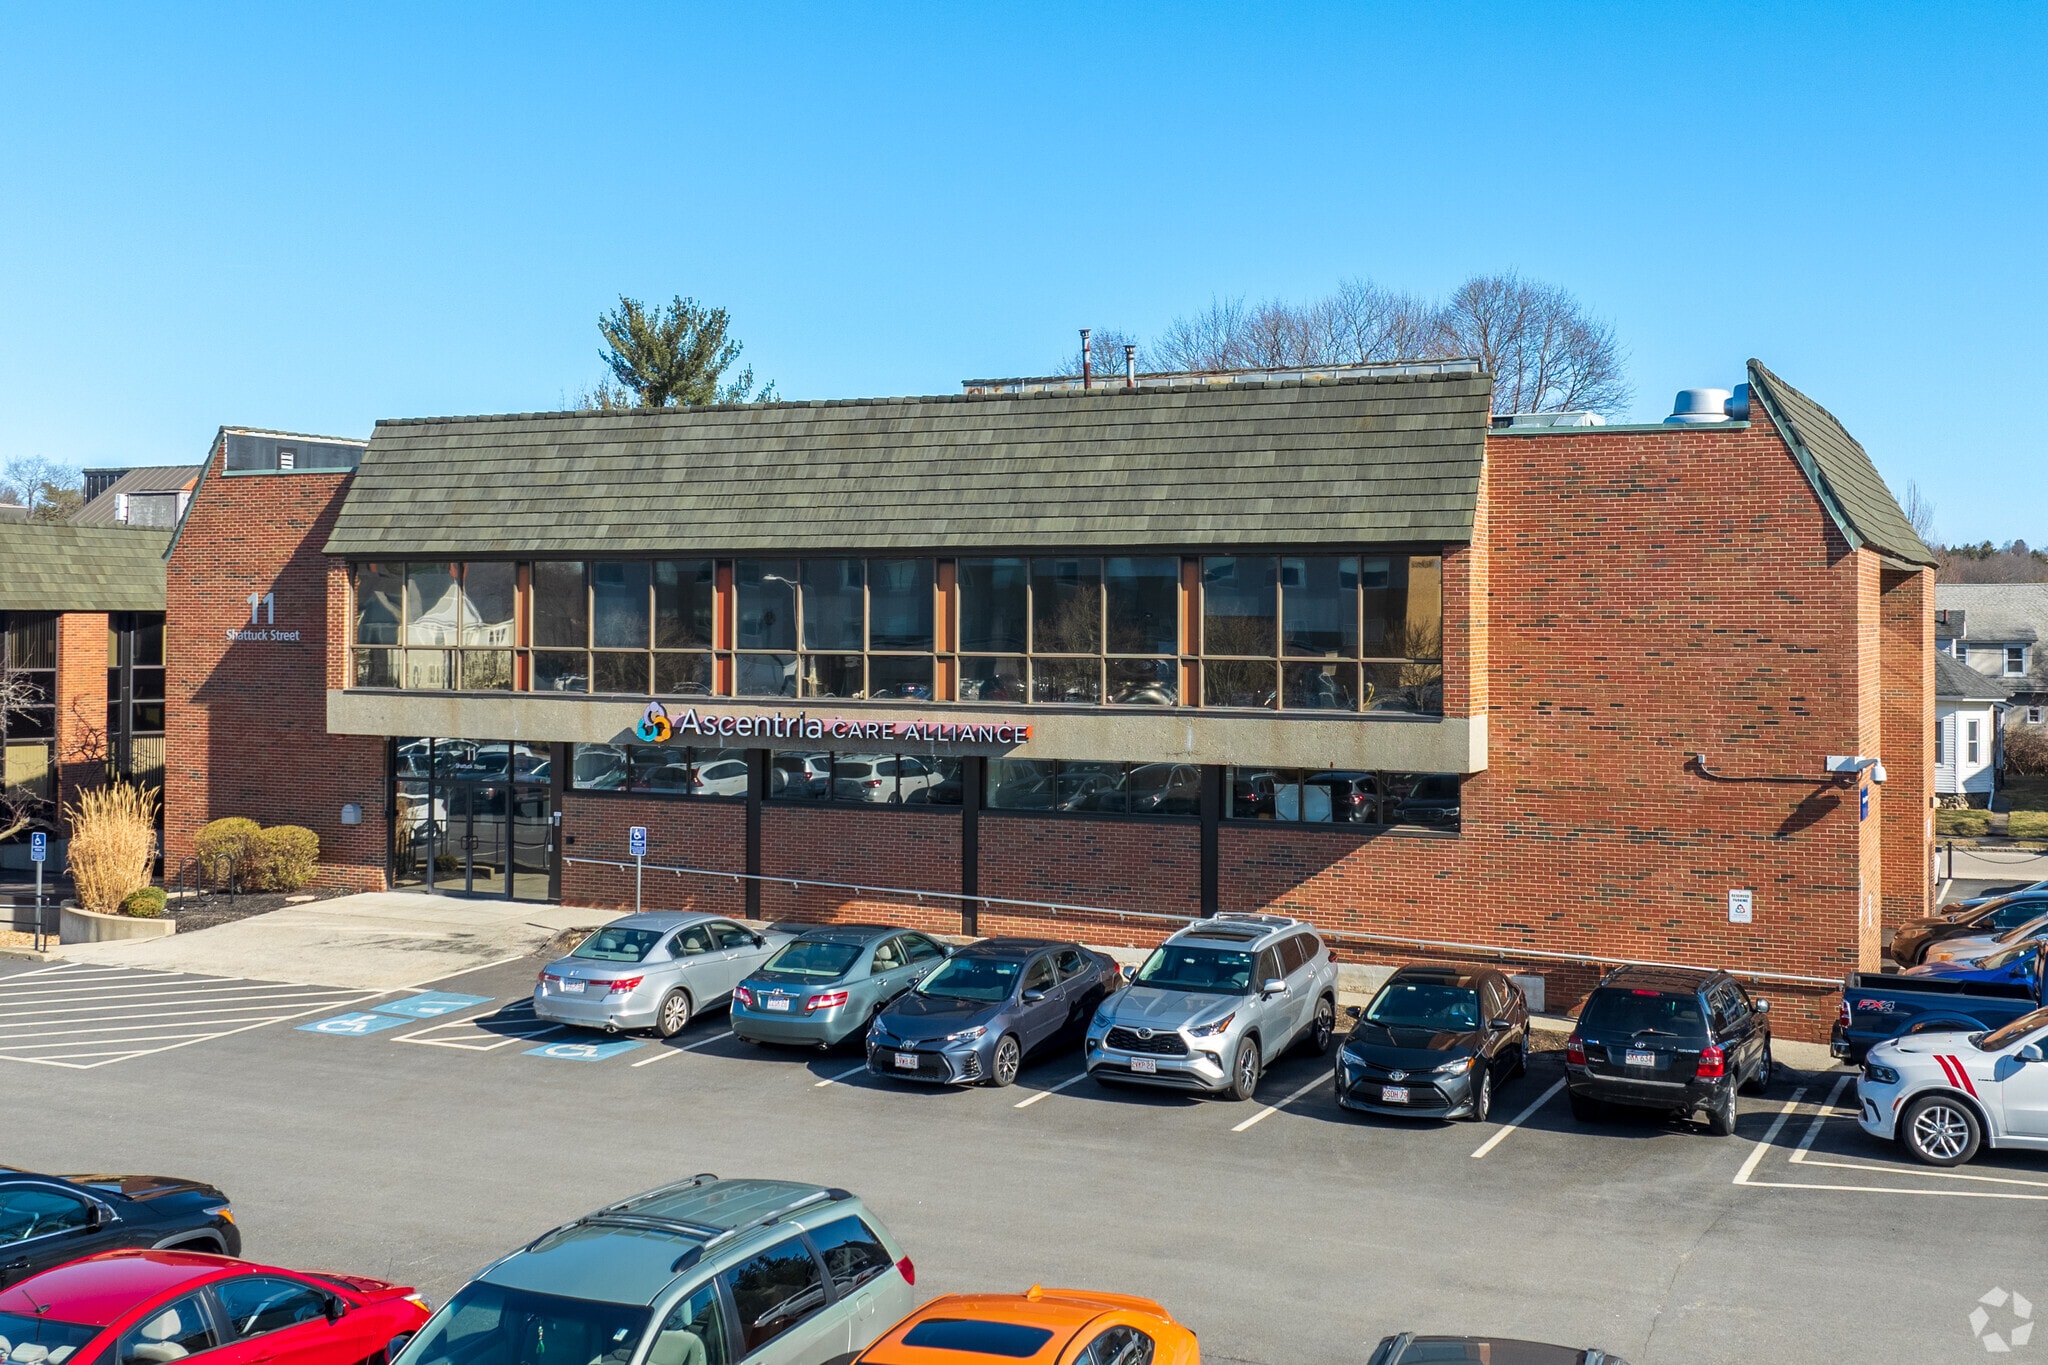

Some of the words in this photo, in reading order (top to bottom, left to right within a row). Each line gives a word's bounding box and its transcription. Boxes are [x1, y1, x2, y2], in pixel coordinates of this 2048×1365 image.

[246, 592, 274, 625] 11
[226, 629, 268, 641] Shattuck
[270, 630, 300, 641] Street
[680, 708, 823, 739] Ascentria
[832, 722, 894, 740] CARE
[905, 724, 1028, 744] ALLIANCE
[466, 746, 476, 761] 11
[1858, 999, 1896, 1011] FX4
